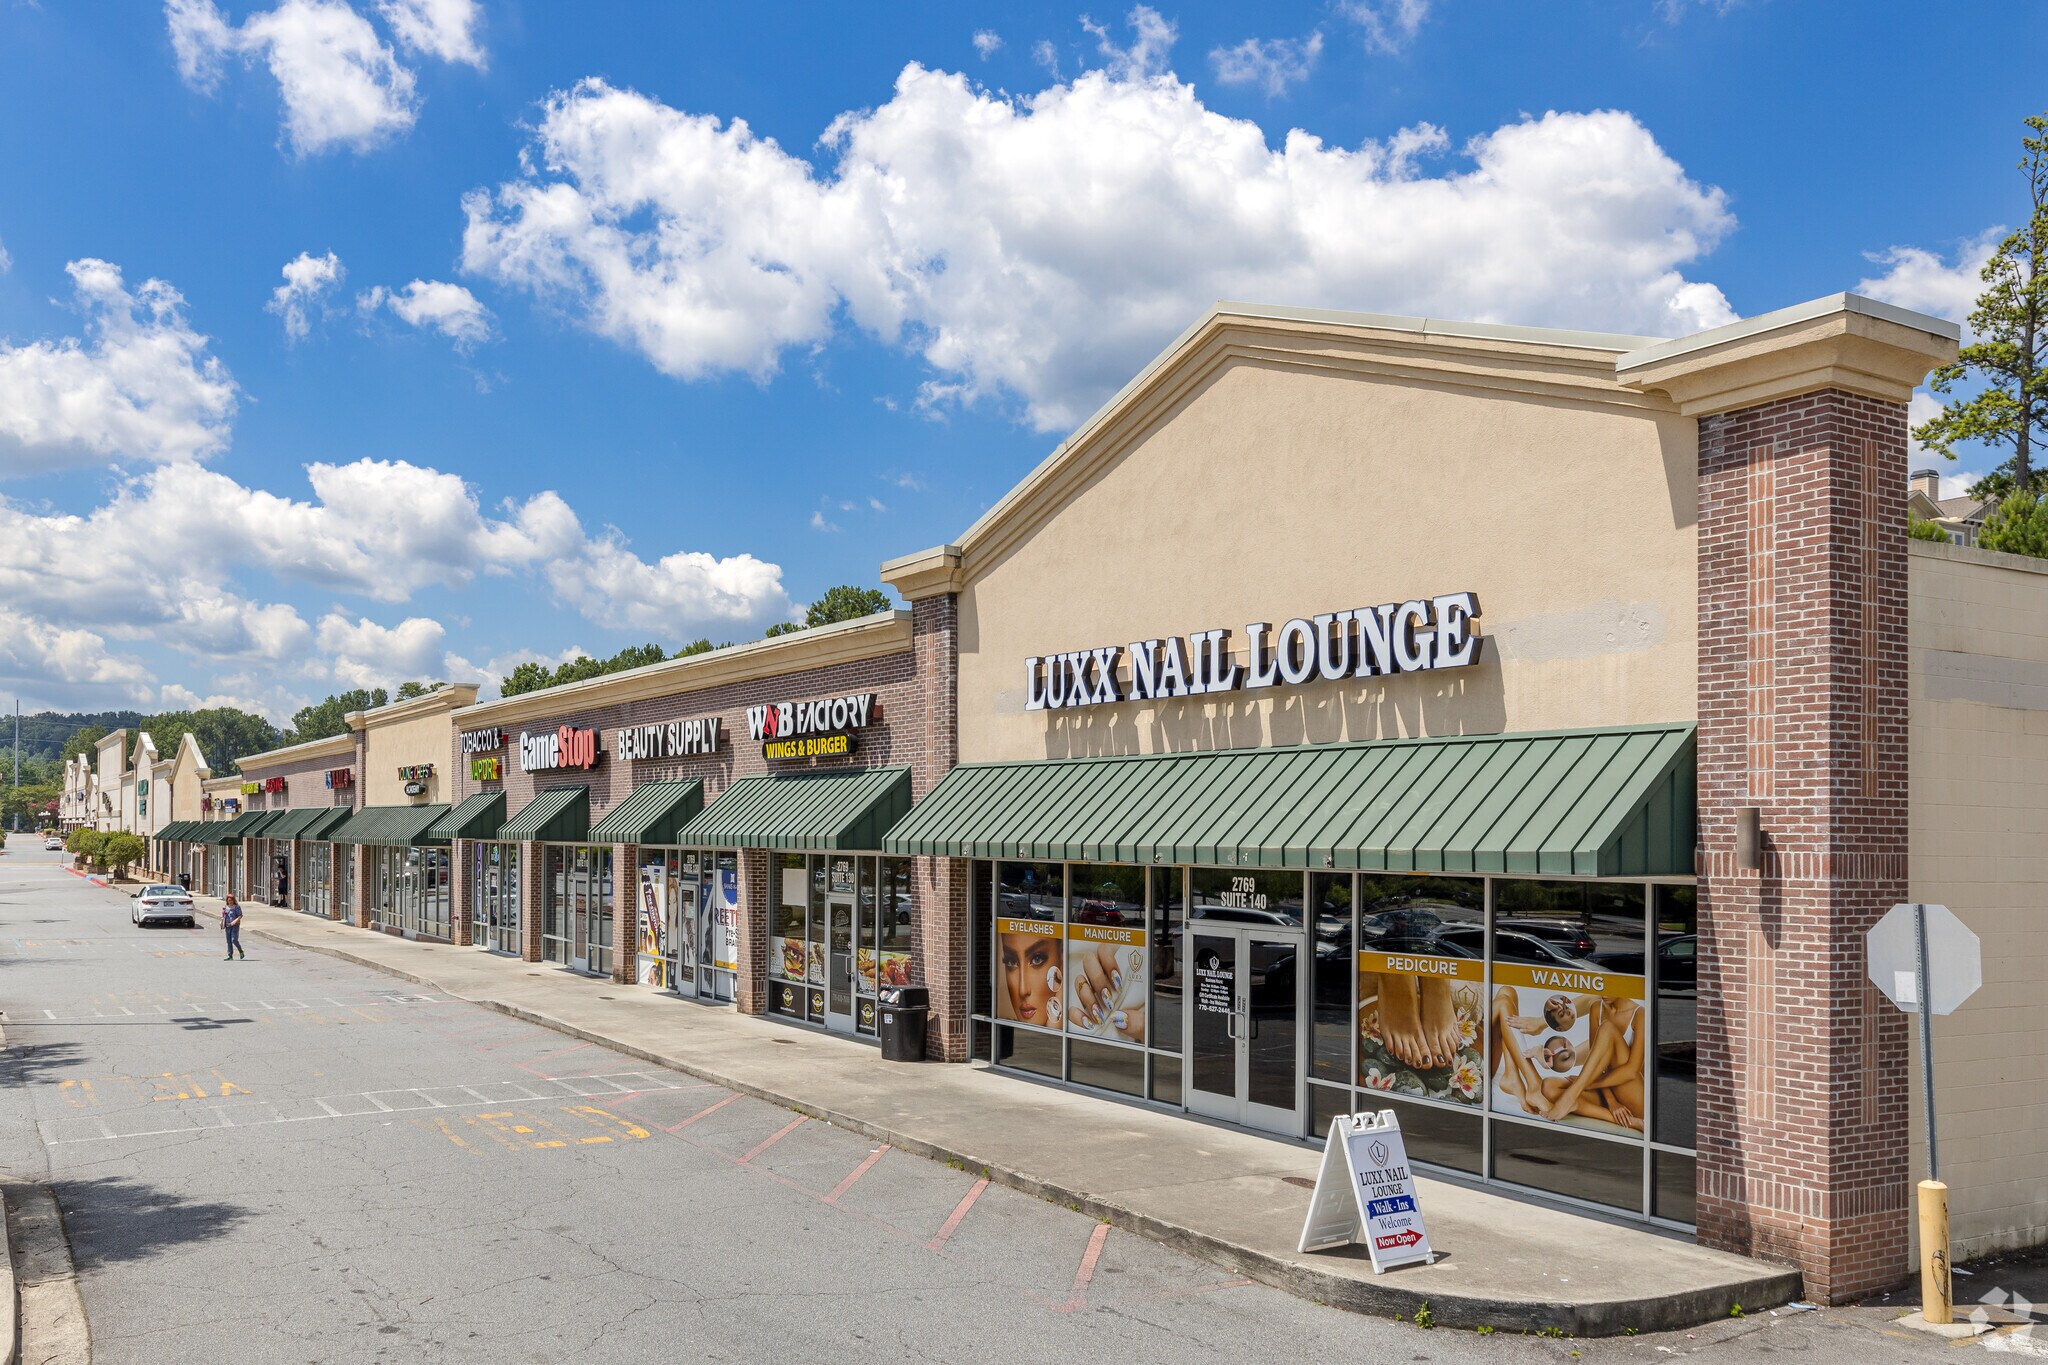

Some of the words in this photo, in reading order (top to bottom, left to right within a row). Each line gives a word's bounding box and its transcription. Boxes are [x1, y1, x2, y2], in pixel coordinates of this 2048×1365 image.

[1025, 646, 1124, 711] LUXX
[1129, 629, 1242, 700] NAIL
[1246, 592, 1483, 688] LOUNGE
[746, 702, 794, 741] WNB
[796, 693, 872, 734] FACTORY
[460, 729, 492, 753] TOBACCO
[493, 727, 500, 750] &
[618, 724, 665, 761] BEAUTY
[667, 717, 720, 756] SUPPLY
[765, 740, 796, 759] WINGS
[797, 740, 805, 757] &
[806, 735, 847, 755] BURGER
[519, 725, 596, 771] GameStop
[837, 861, 849, 872] 2769
[831, 872, 845, 883] SUITE
[846, 872, 855, 884] 130
[1232, 876, 1255, 893] 2769
[1221, 892, 1247, 908] SUITE
[1249, 893, 1267, 909] 140
[1009, 921, 1054, 935] EYELASHES
[1084, 927, 1131, 942] MANICURE
[1386, 956, 1458, 976] PEDICURE
[1217, 971, 1233, 980] LOUNGE
[1531, 969, 1605, 991] WAXING
[1360, 1169, 1386, 1186] LUXX
[1384, 1167, 1408, 1182] NAIL
[1371, 1184, 1404, 1198] LOUNGE
[1373, 1202, 1392, 1215] Walk
[1397, 1200, 1409, 1211] Ins
[1378, 1217, 1412, 1230] Welcome
[1379, 1236, 1395, 1247] Now
[1396, 1233, 1416, 1245] Open
